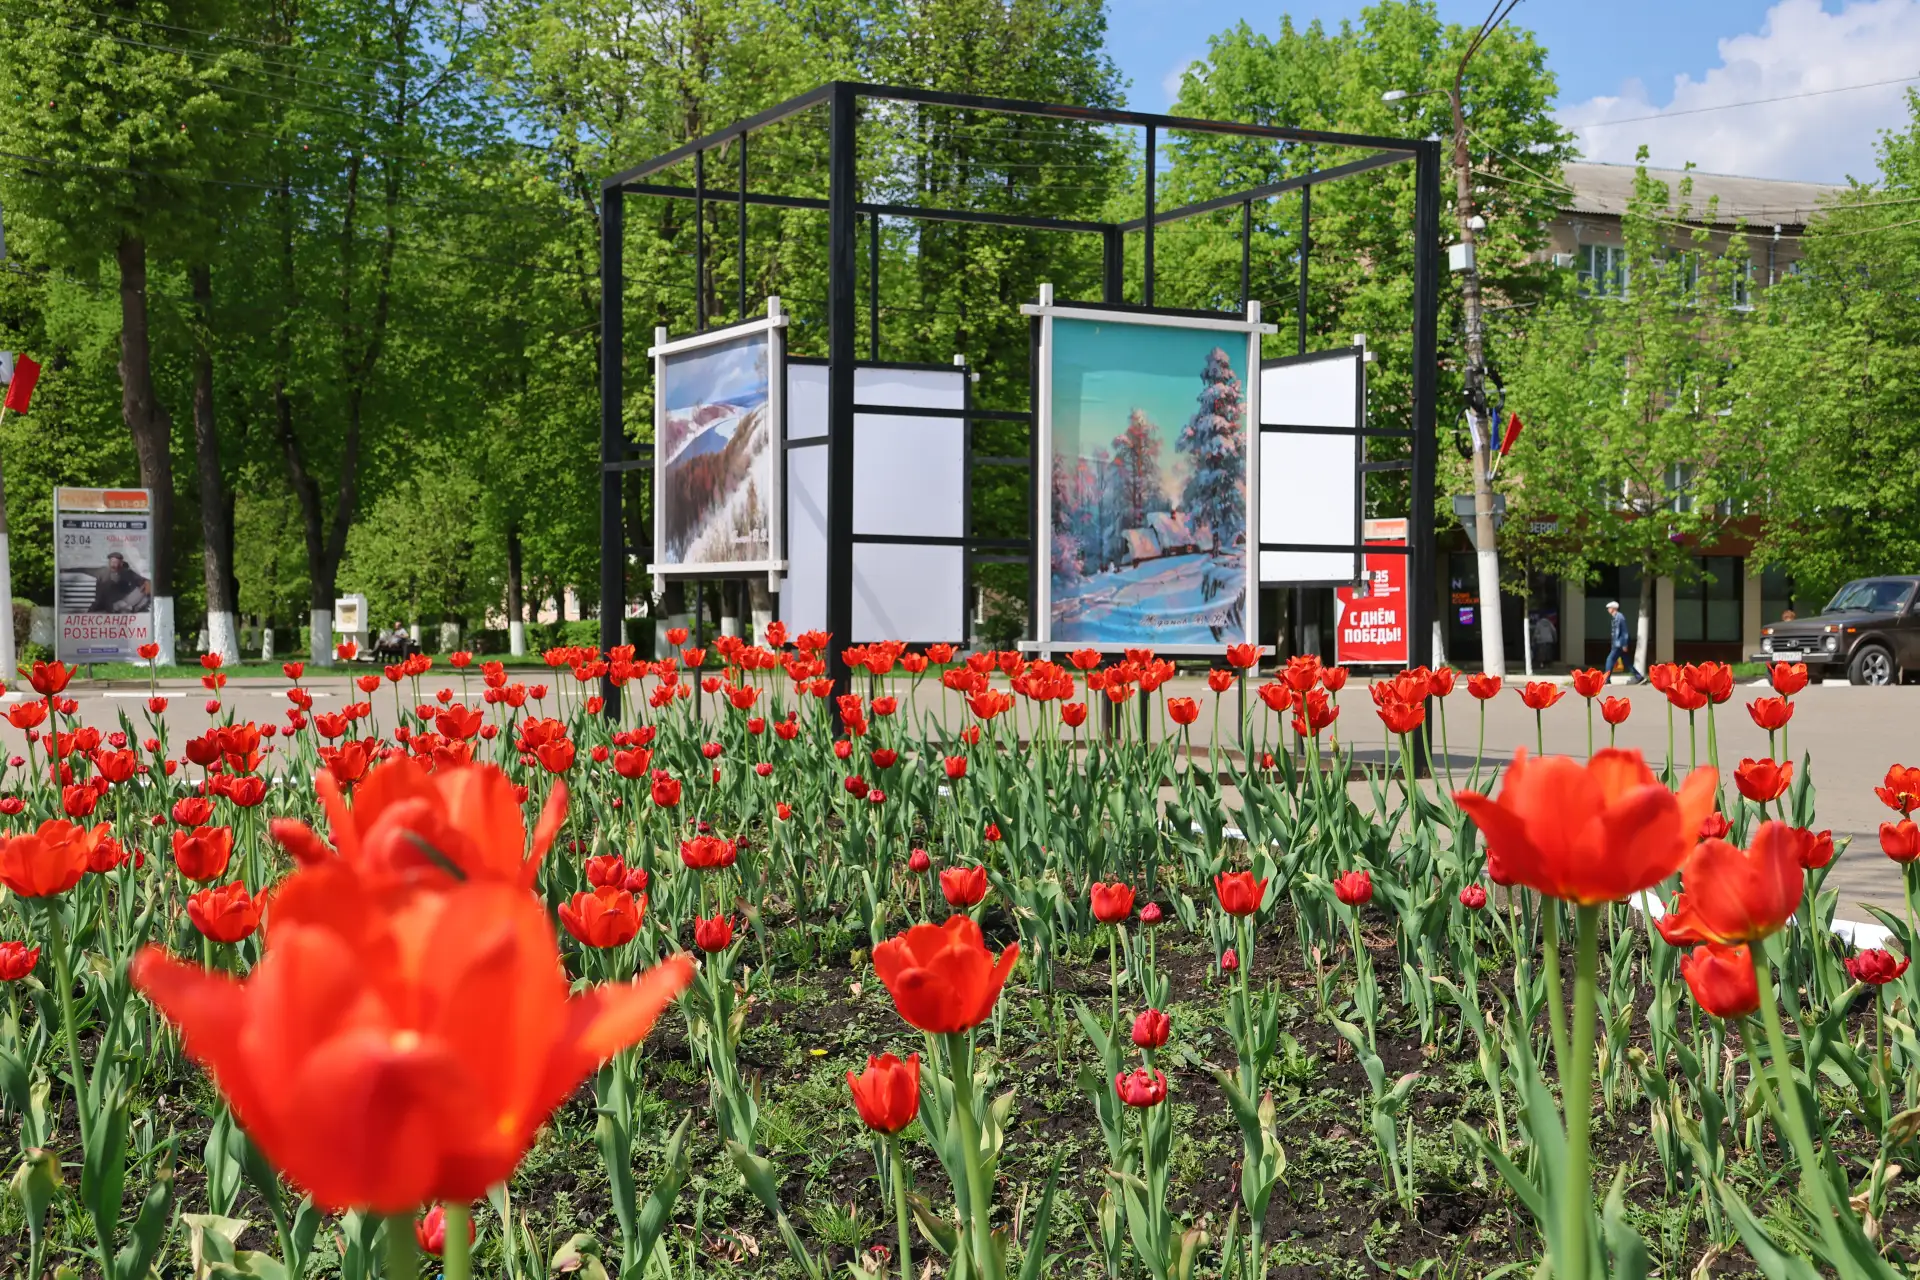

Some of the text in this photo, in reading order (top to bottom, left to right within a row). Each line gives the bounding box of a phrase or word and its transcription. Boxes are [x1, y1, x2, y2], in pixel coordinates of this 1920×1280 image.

[64, 534, 91, 544] 23.04
[65, 615, 137, 628] АЛЕКСАНДР
[1350, 608, 1396, 628] С ДНЁМ
[63, 627, 147, 639] РОЗЕНБАУМ
[1344, 628, 1402, 645] ПОБЕДЫ!
